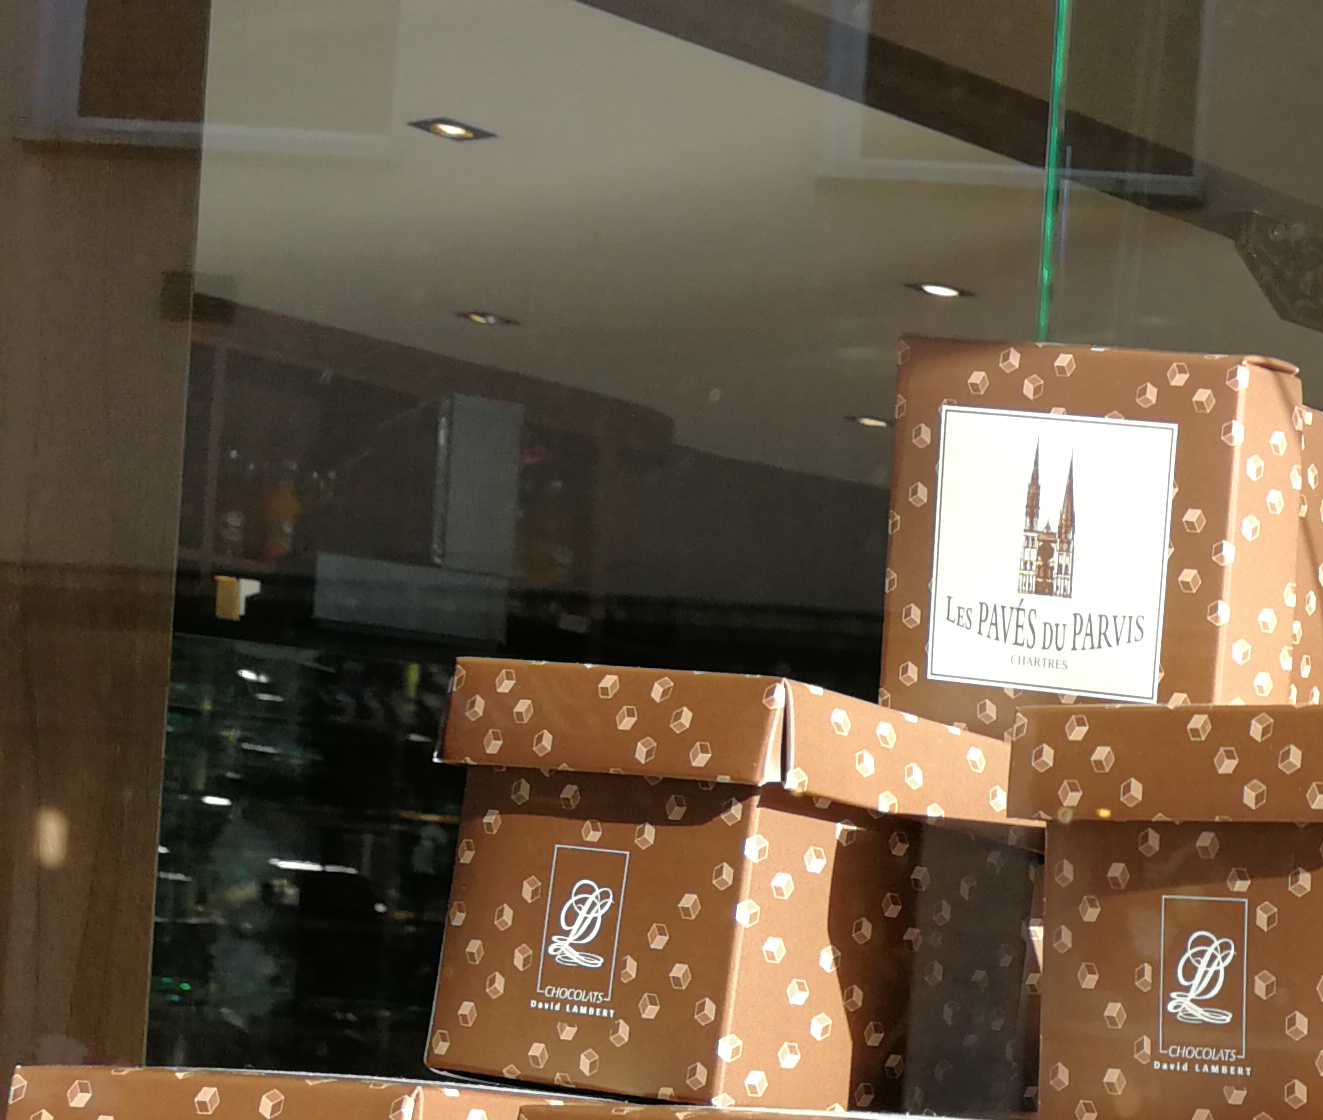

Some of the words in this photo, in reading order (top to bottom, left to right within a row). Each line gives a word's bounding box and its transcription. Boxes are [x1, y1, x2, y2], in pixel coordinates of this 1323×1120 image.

[977, 598, 1037, 650] PAVÉS
[1071, 612, 1145, 651] PARVIS
[1010, 654, 1069, 671] CHARTRES
[544, 986, 604, 1004] CHOCOLATS
[530, 1000, 560, 1011] David
[566, 1004, 615, 1018] LAMBERT
[1168, 1045, 1237, 1062] CHOCOLATS
[1154, 1061, 1188, 1072] David
[1195, 1064, 1251, 1076] LAMBERT
